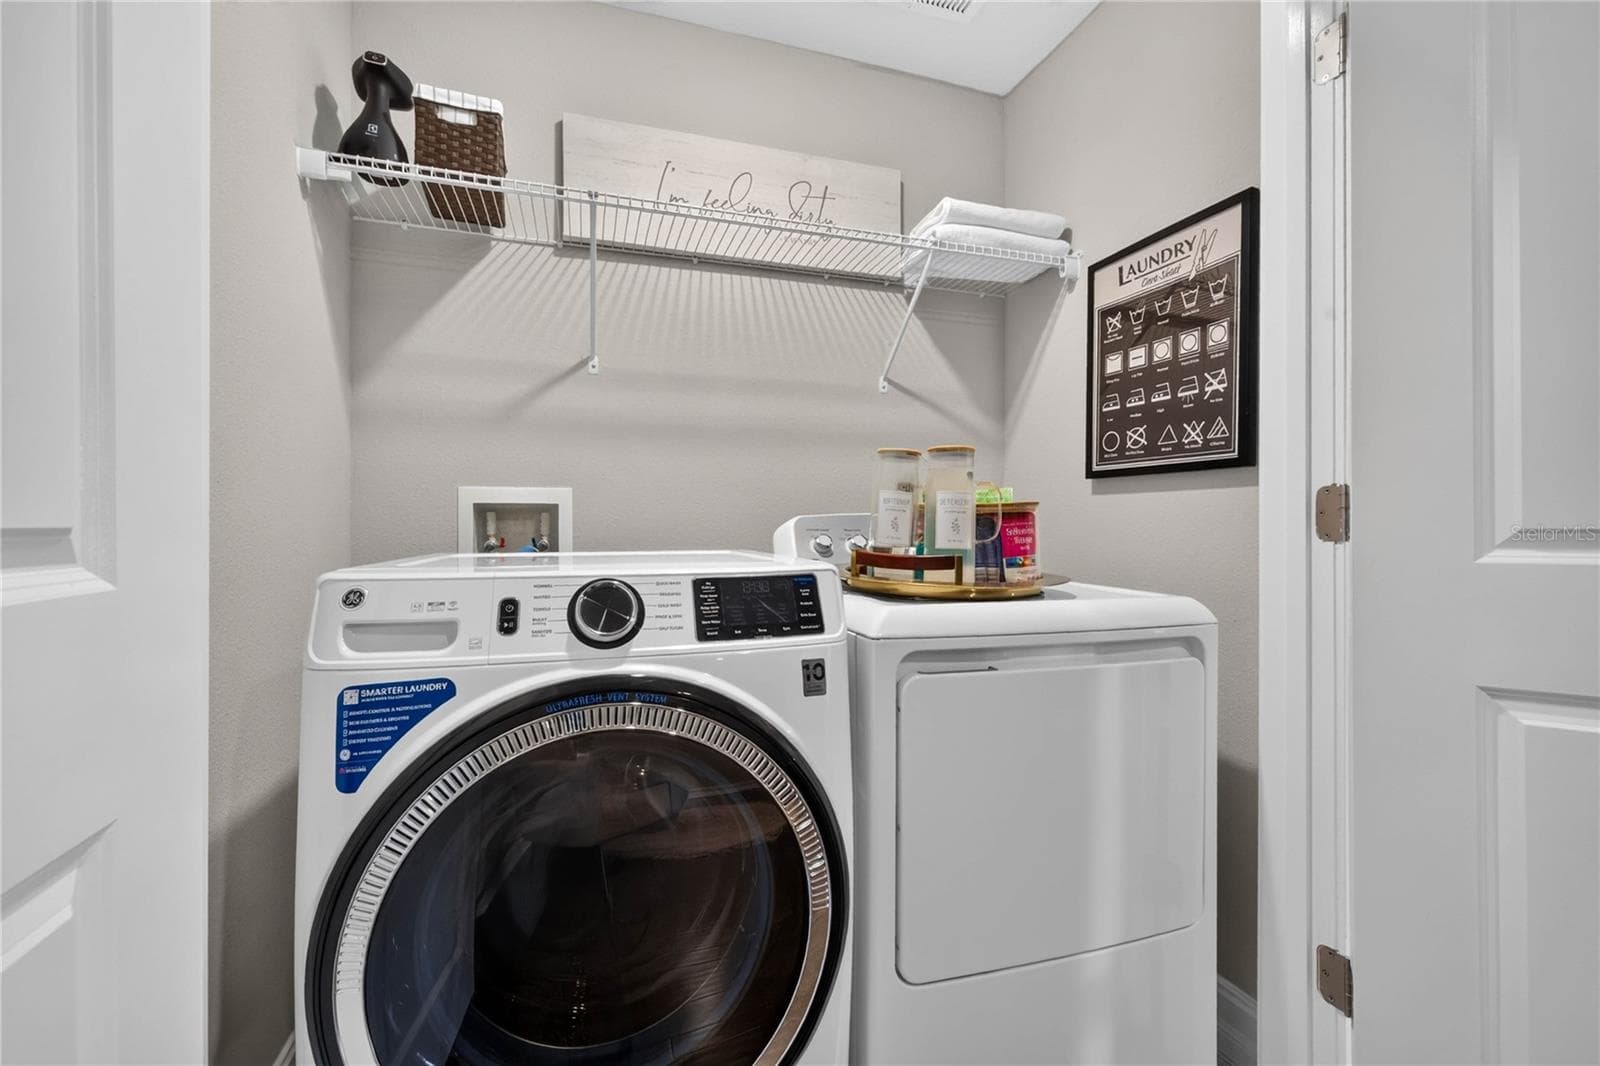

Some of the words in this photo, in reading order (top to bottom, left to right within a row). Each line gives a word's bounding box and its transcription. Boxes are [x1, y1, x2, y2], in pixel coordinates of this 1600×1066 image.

[1118, 234, 1197, 287] LAUNDRY
[803, 662, 825, 681] 10
[360, 685, 404, 698] SMARTER
[405, 682, 448, 694] LAUNDRY
